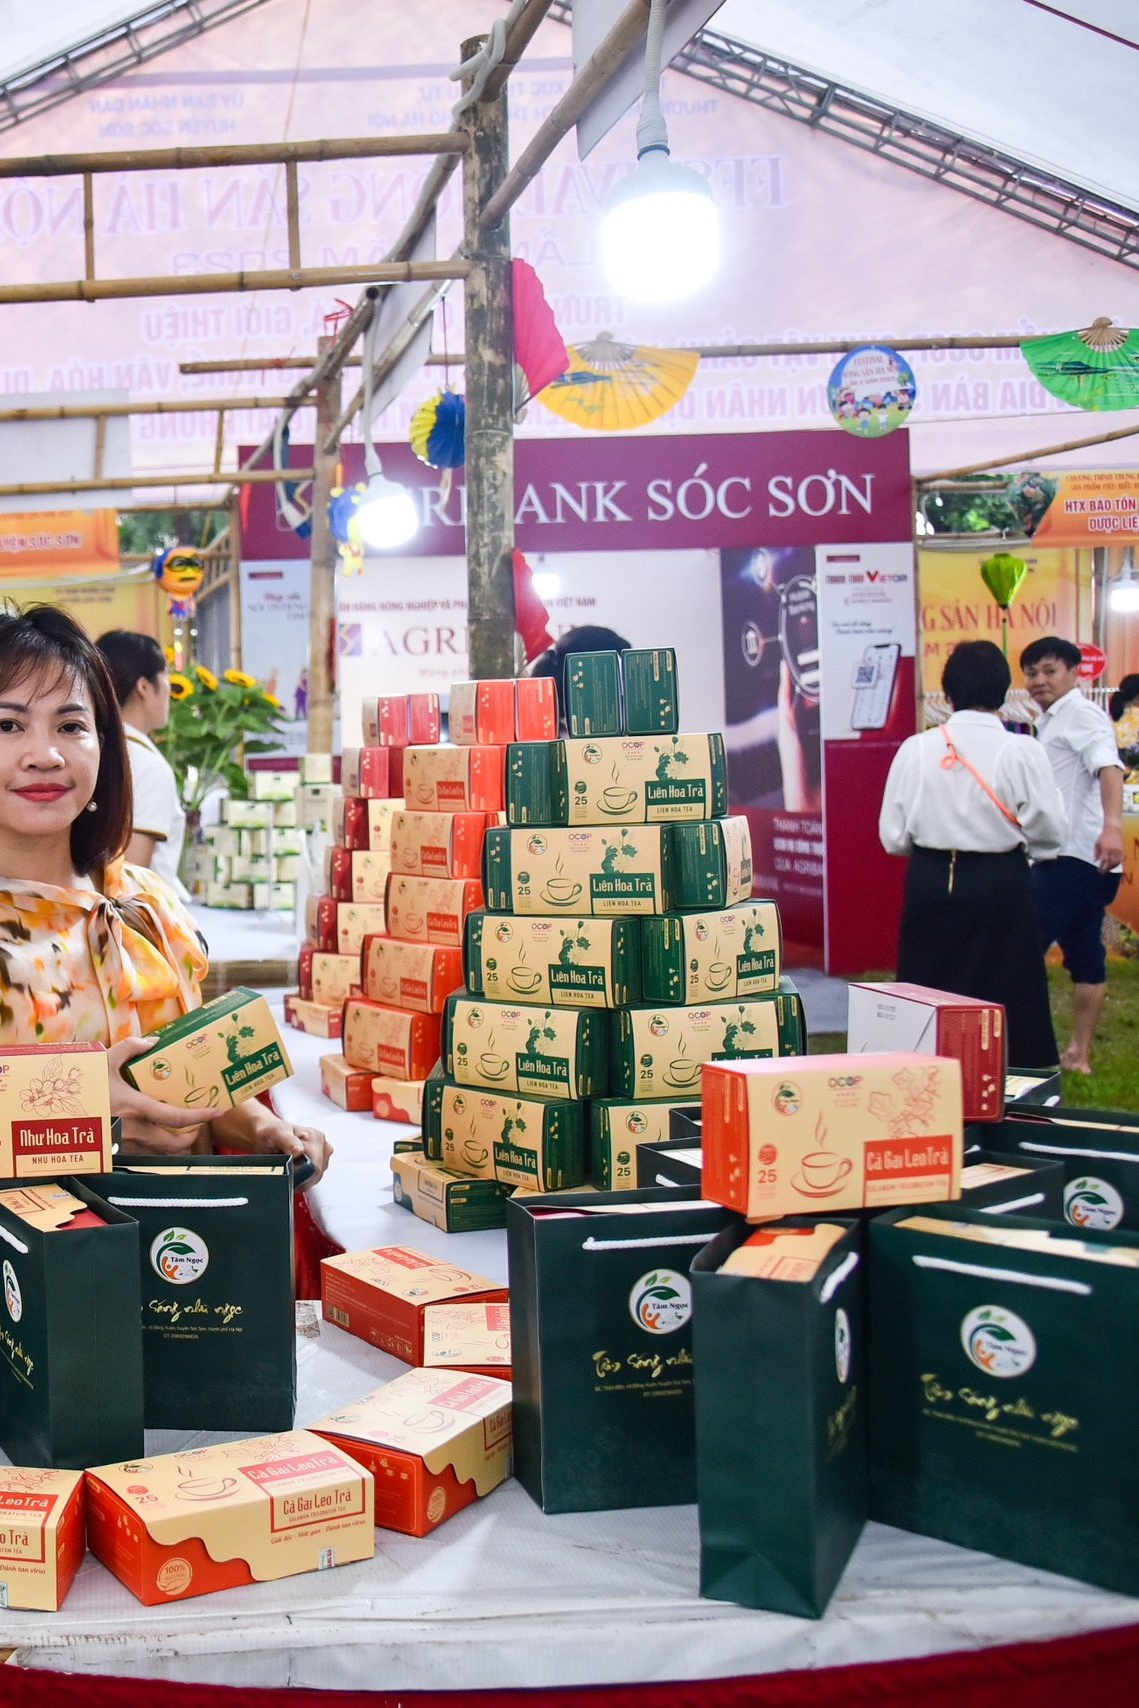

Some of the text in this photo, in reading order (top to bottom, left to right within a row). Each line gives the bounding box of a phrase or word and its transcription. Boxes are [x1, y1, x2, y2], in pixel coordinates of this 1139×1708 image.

[647, 464, 751, 523] SÓC
[767, 468, 875, 519] SƠN
[1065, 501, 1086, 512] HTX
[622, 741, 644, 749] OCOP
[648, 783, 703, 799] Liên Hoa Trà
[574, 796, 587, 805] 25
[568, 832, 592, 841] OCOP
[518, 886, 531, 896] 25
[593, 877, 653, 893] Liên Hoa Trà
[763, 955, 774, 969] Trà
[487, 973, 498, 981] 25
[551, 966, 604, 985] Liên Hoa Trà
[690, 975, 699, 984] 25
[186, 1033, 208, 1050] OCOP
[225, 1047, 280, 1086] Liên Hoa Trà
[518, 1056, 568, 1077] Liên Hoa Trà
[640, 1069, 653, 1079] 25
[828, 1075, 862, 1088] OCOP
[20, 1126, 95, 1147] Như Hoa Trà
[32, 1155, 84, 1165] NHU HOA TEA
[866, 1151, 882, 1172] Cà
[617, 1167, 631, 1177] 25
[758, 1169, 777, 1184] 25
[170, 1256, 204, 1265] Tâm Ngọc
[283, 1489, 351, 1515] Cà Gai Leo Trà
[10, 1528, 28, 1546] Trà
